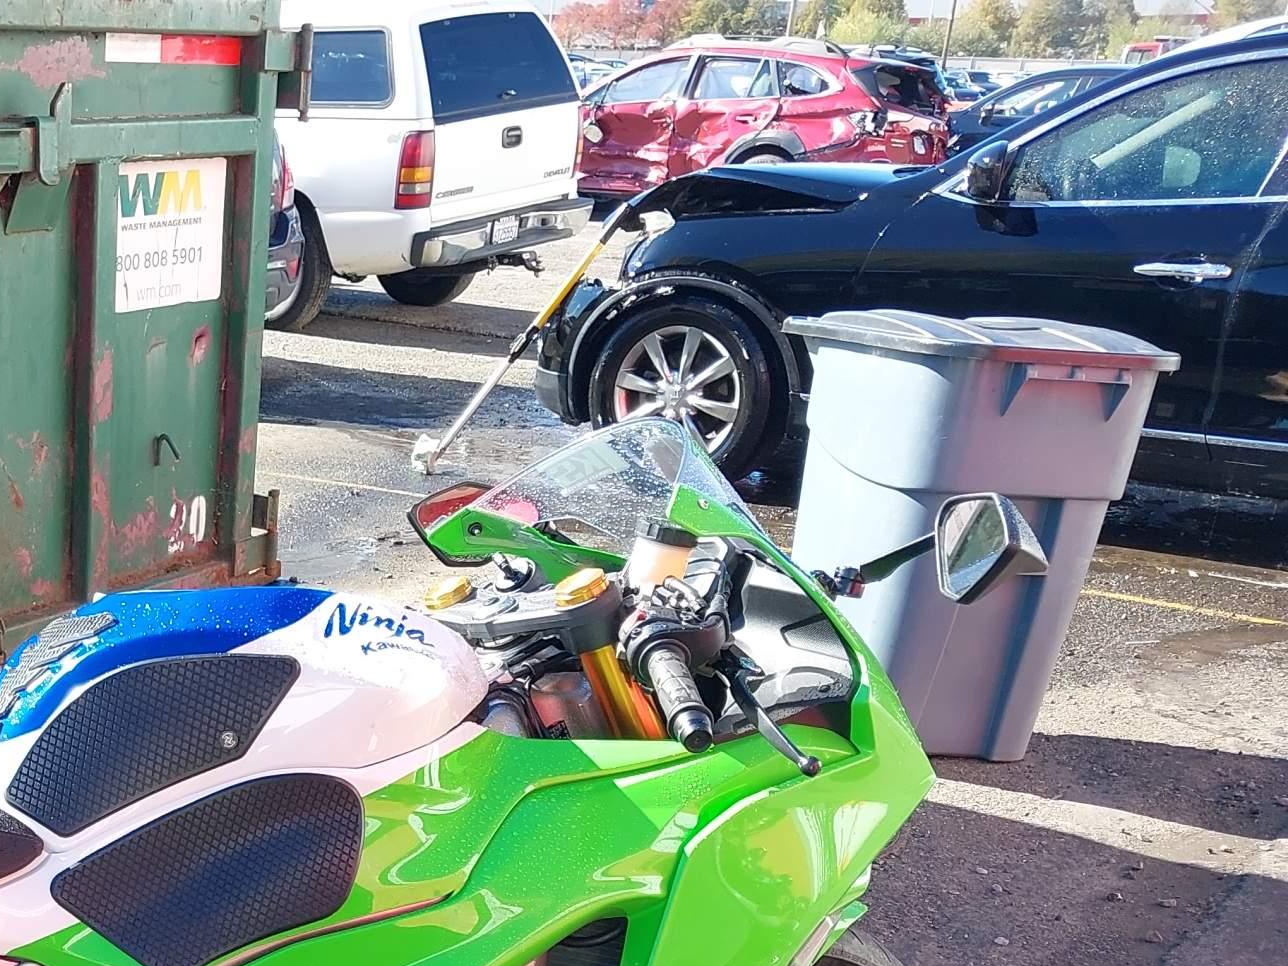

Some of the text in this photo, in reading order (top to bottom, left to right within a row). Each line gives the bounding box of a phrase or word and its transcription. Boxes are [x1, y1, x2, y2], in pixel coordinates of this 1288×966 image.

[118, 169, 202, 218] WM
[121, 217, 202, 232] WASTE MANAGEMENT
[116, 246, 203, 273] 800 808 5901
[136, 283, 182, 302] wm.com
[323, 602, 435, 648] Ninja
[360, 640, 438, 661] Kawa
